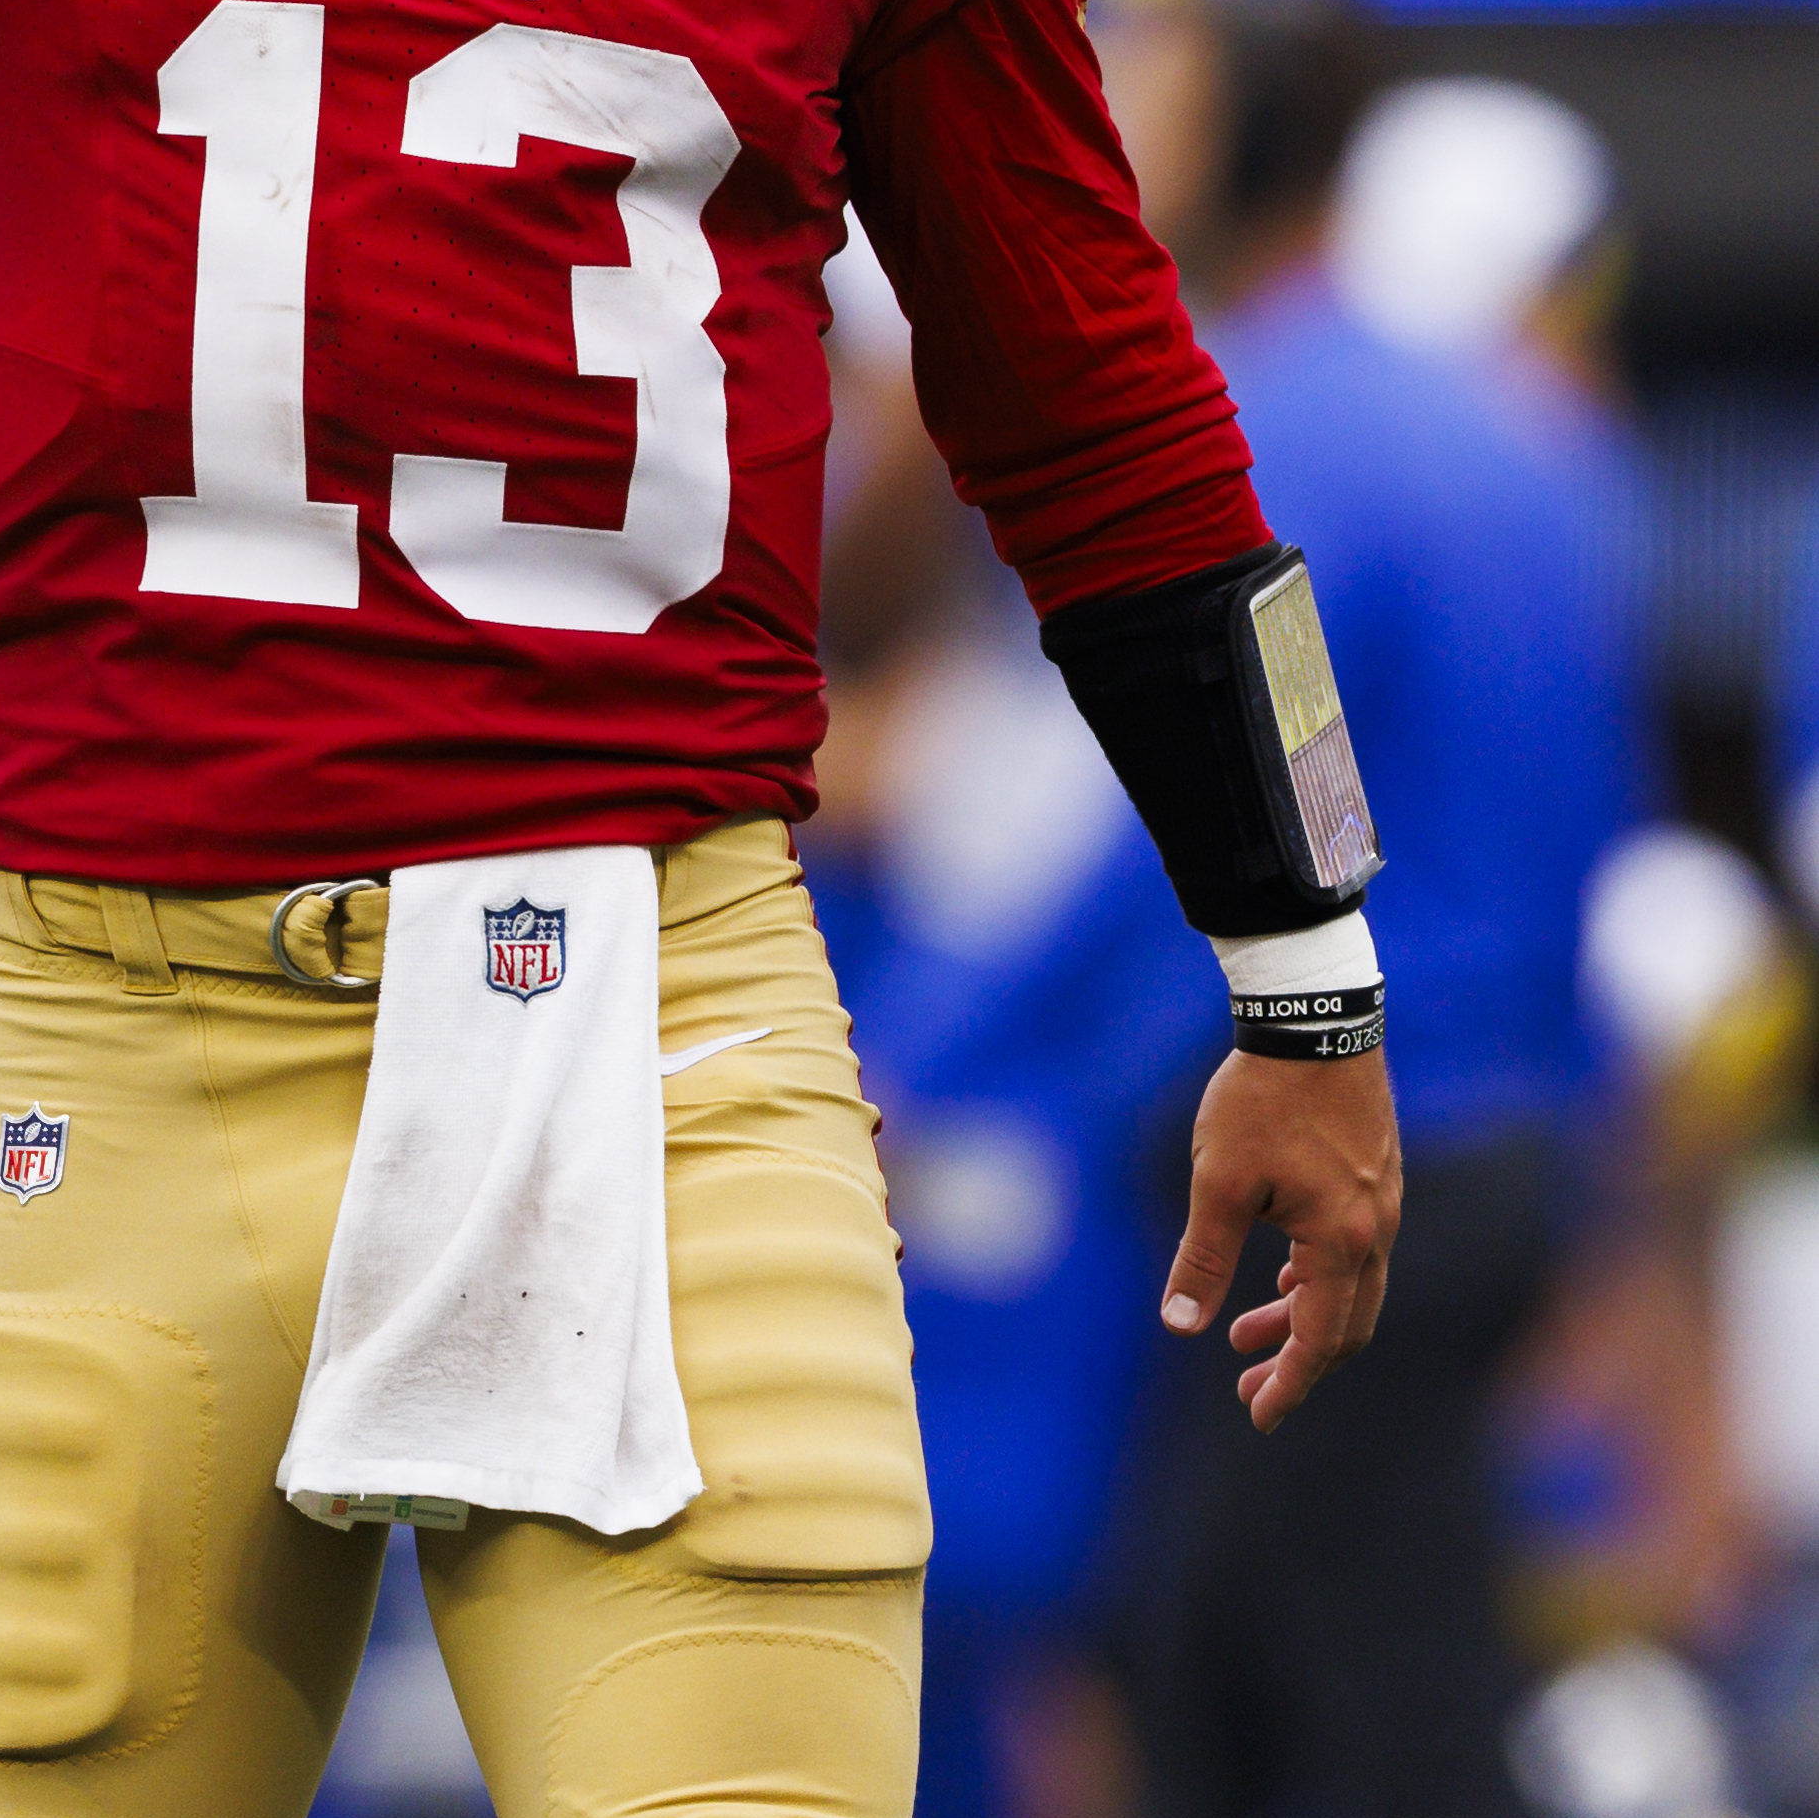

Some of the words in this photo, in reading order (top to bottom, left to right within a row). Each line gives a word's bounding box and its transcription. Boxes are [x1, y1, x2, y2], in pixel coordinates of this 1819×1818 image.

[139, 0, 742, 635] 13
[493, 943, 558, 990] NFL
[1246, 1001, 1264, 1018] BE
[1268, 999, 1308, 1017] NOT
[1313, 996, 1343, 1014] DO
[5, 1149, 52, 1186] NFL
